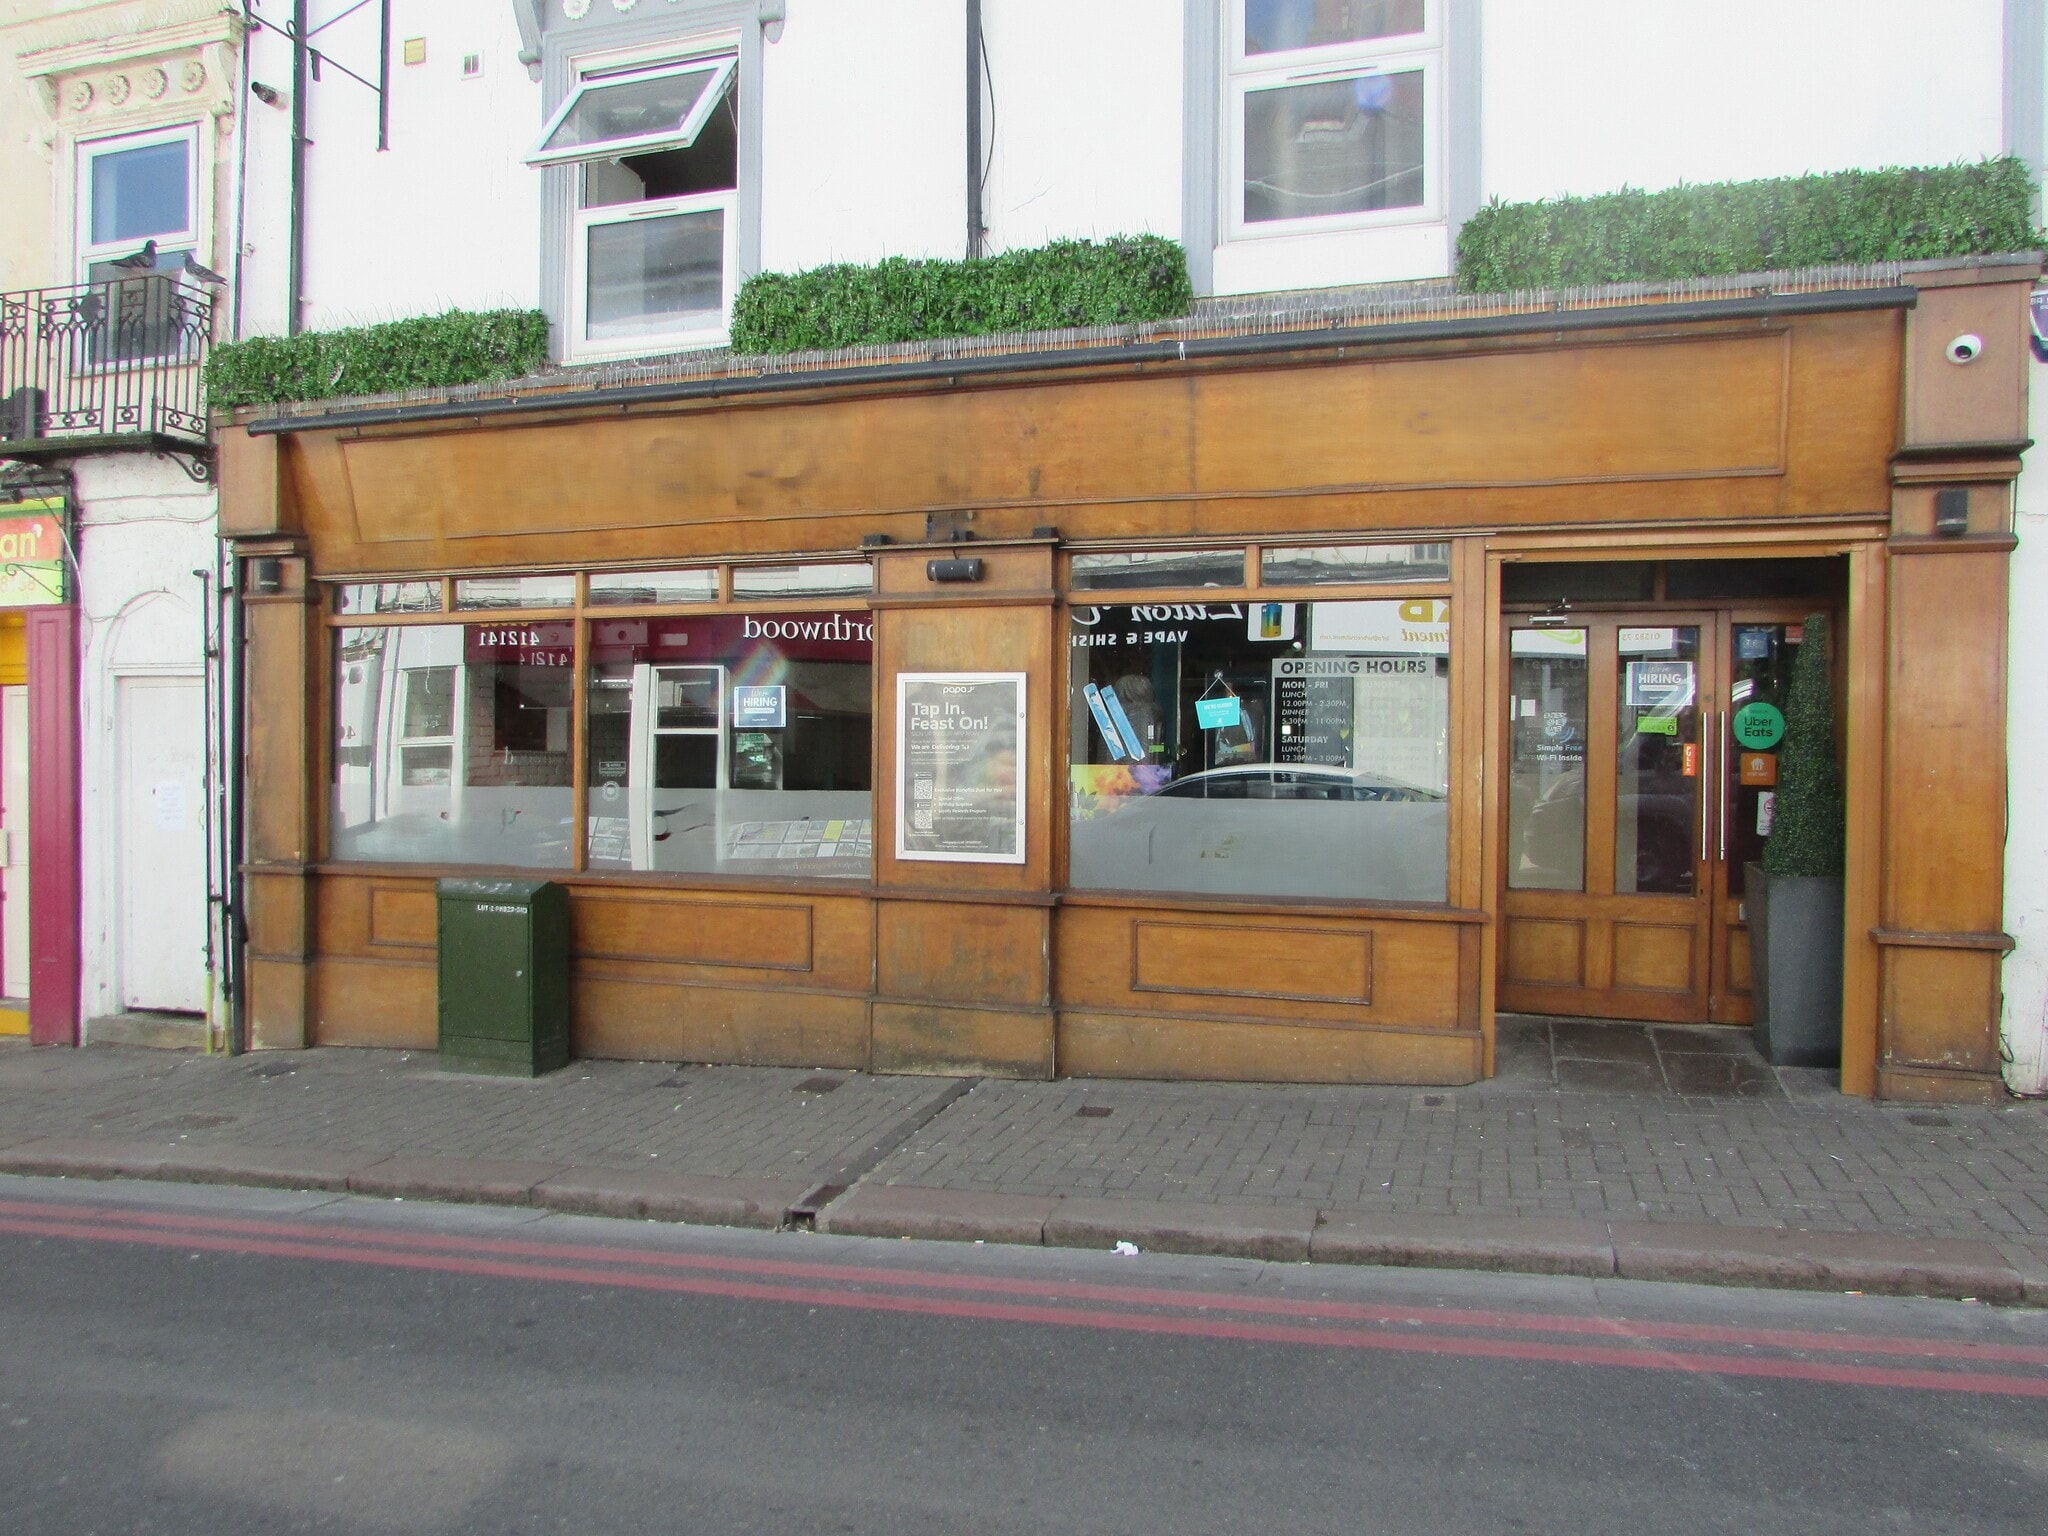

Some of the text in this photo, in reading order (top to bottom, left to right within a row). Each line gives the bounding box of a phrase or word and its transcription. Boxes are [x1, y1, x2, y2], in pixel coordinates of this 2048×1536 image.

[1281, 660, 1427, 674] OPENING HOURS
[1638, 673, 1682, 684] HIRING
[1282, 681, 1306, 689] MON
[1315, 681, 1329, 689] FRI
[743, 697, 778, 707] HIRING
[911, 701, 966, 719] Tap In.
[911, 716, 989, 731] Feast On!
[1744, 716, 1773, 727] Uber
[1744, 727, 1773, 737] Eats
[1282, 736, 1329, 744] SATURDAY
[1536, 744, 1564, 752] Simple
